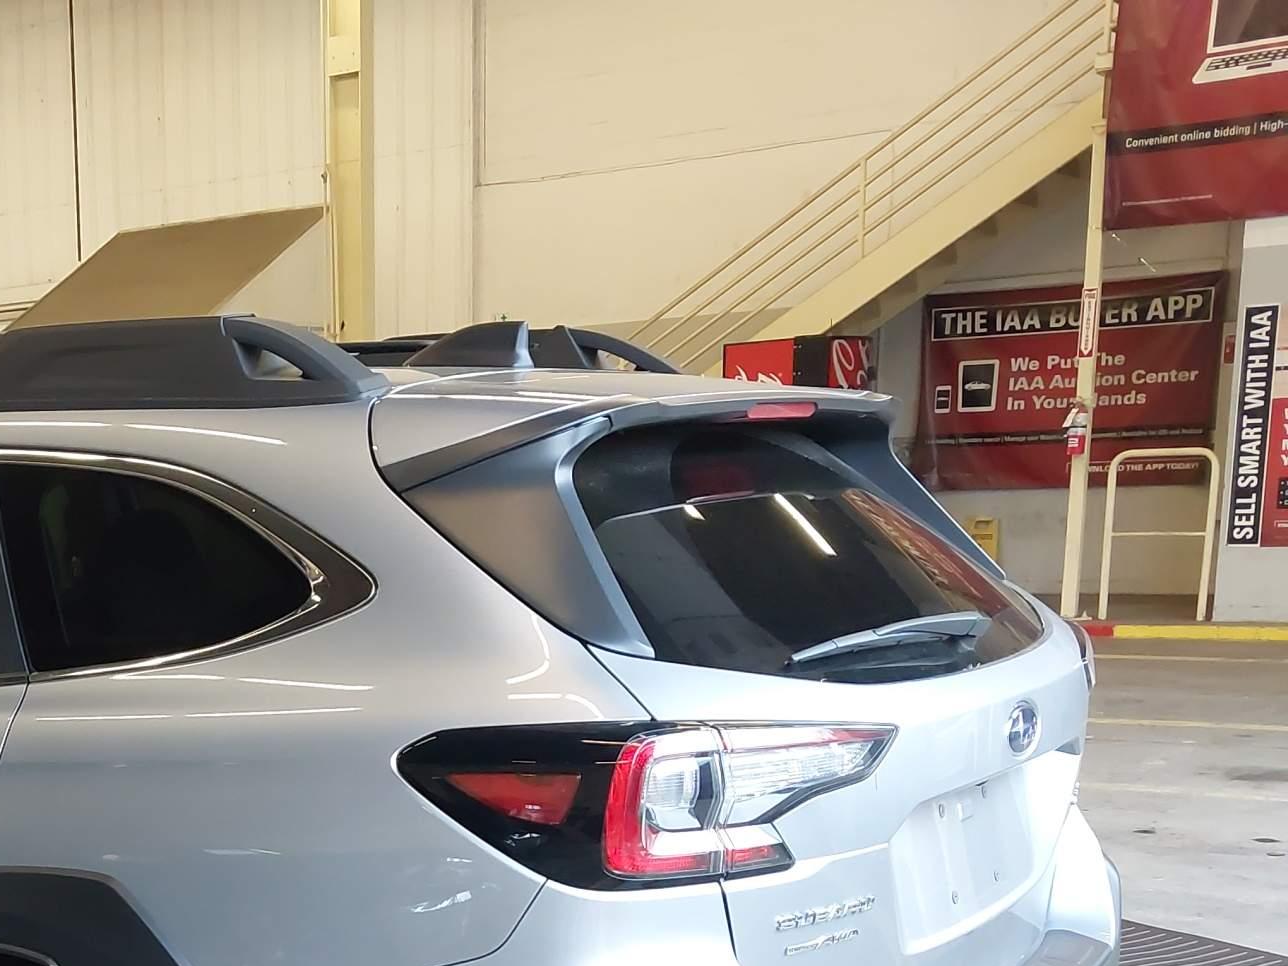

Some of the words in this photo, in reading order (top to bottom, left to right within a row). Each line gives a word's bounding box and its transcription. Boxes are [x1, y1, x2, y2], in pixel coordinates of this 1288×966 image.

[1125, 134, 1178, 149] Convenient
[1181, 129, 1211, 142] online
[1214, 124, 1251, 138] bidding
[941, 310, 988, 335] THE
[996, 308, 1041, 332] IAA
[1049, 300, 1139, 328] BUER
[1146, 293, 1203, 321] APP
[1248, 309, 1273, 349] IAA
[1010, 356, 1040, 372] We
[1095, 351, 1126, 366] he
[1008, 375, 1045, 391] IAA
[1049, 371, 1125, 389] Auion
[1131, 369, 1199, 385] Center
[1243, 354, 1269, 410] WITH
[1006, 396, 1025, 411] In
[1097, 389, 1147, 407] ands
[1238, 414, 1263, 488] SMART
[1126, 464, 1143, 472] THE
[1145, 463, 1165, 471] APP
[1233, 492, 1257, 540] SELL
